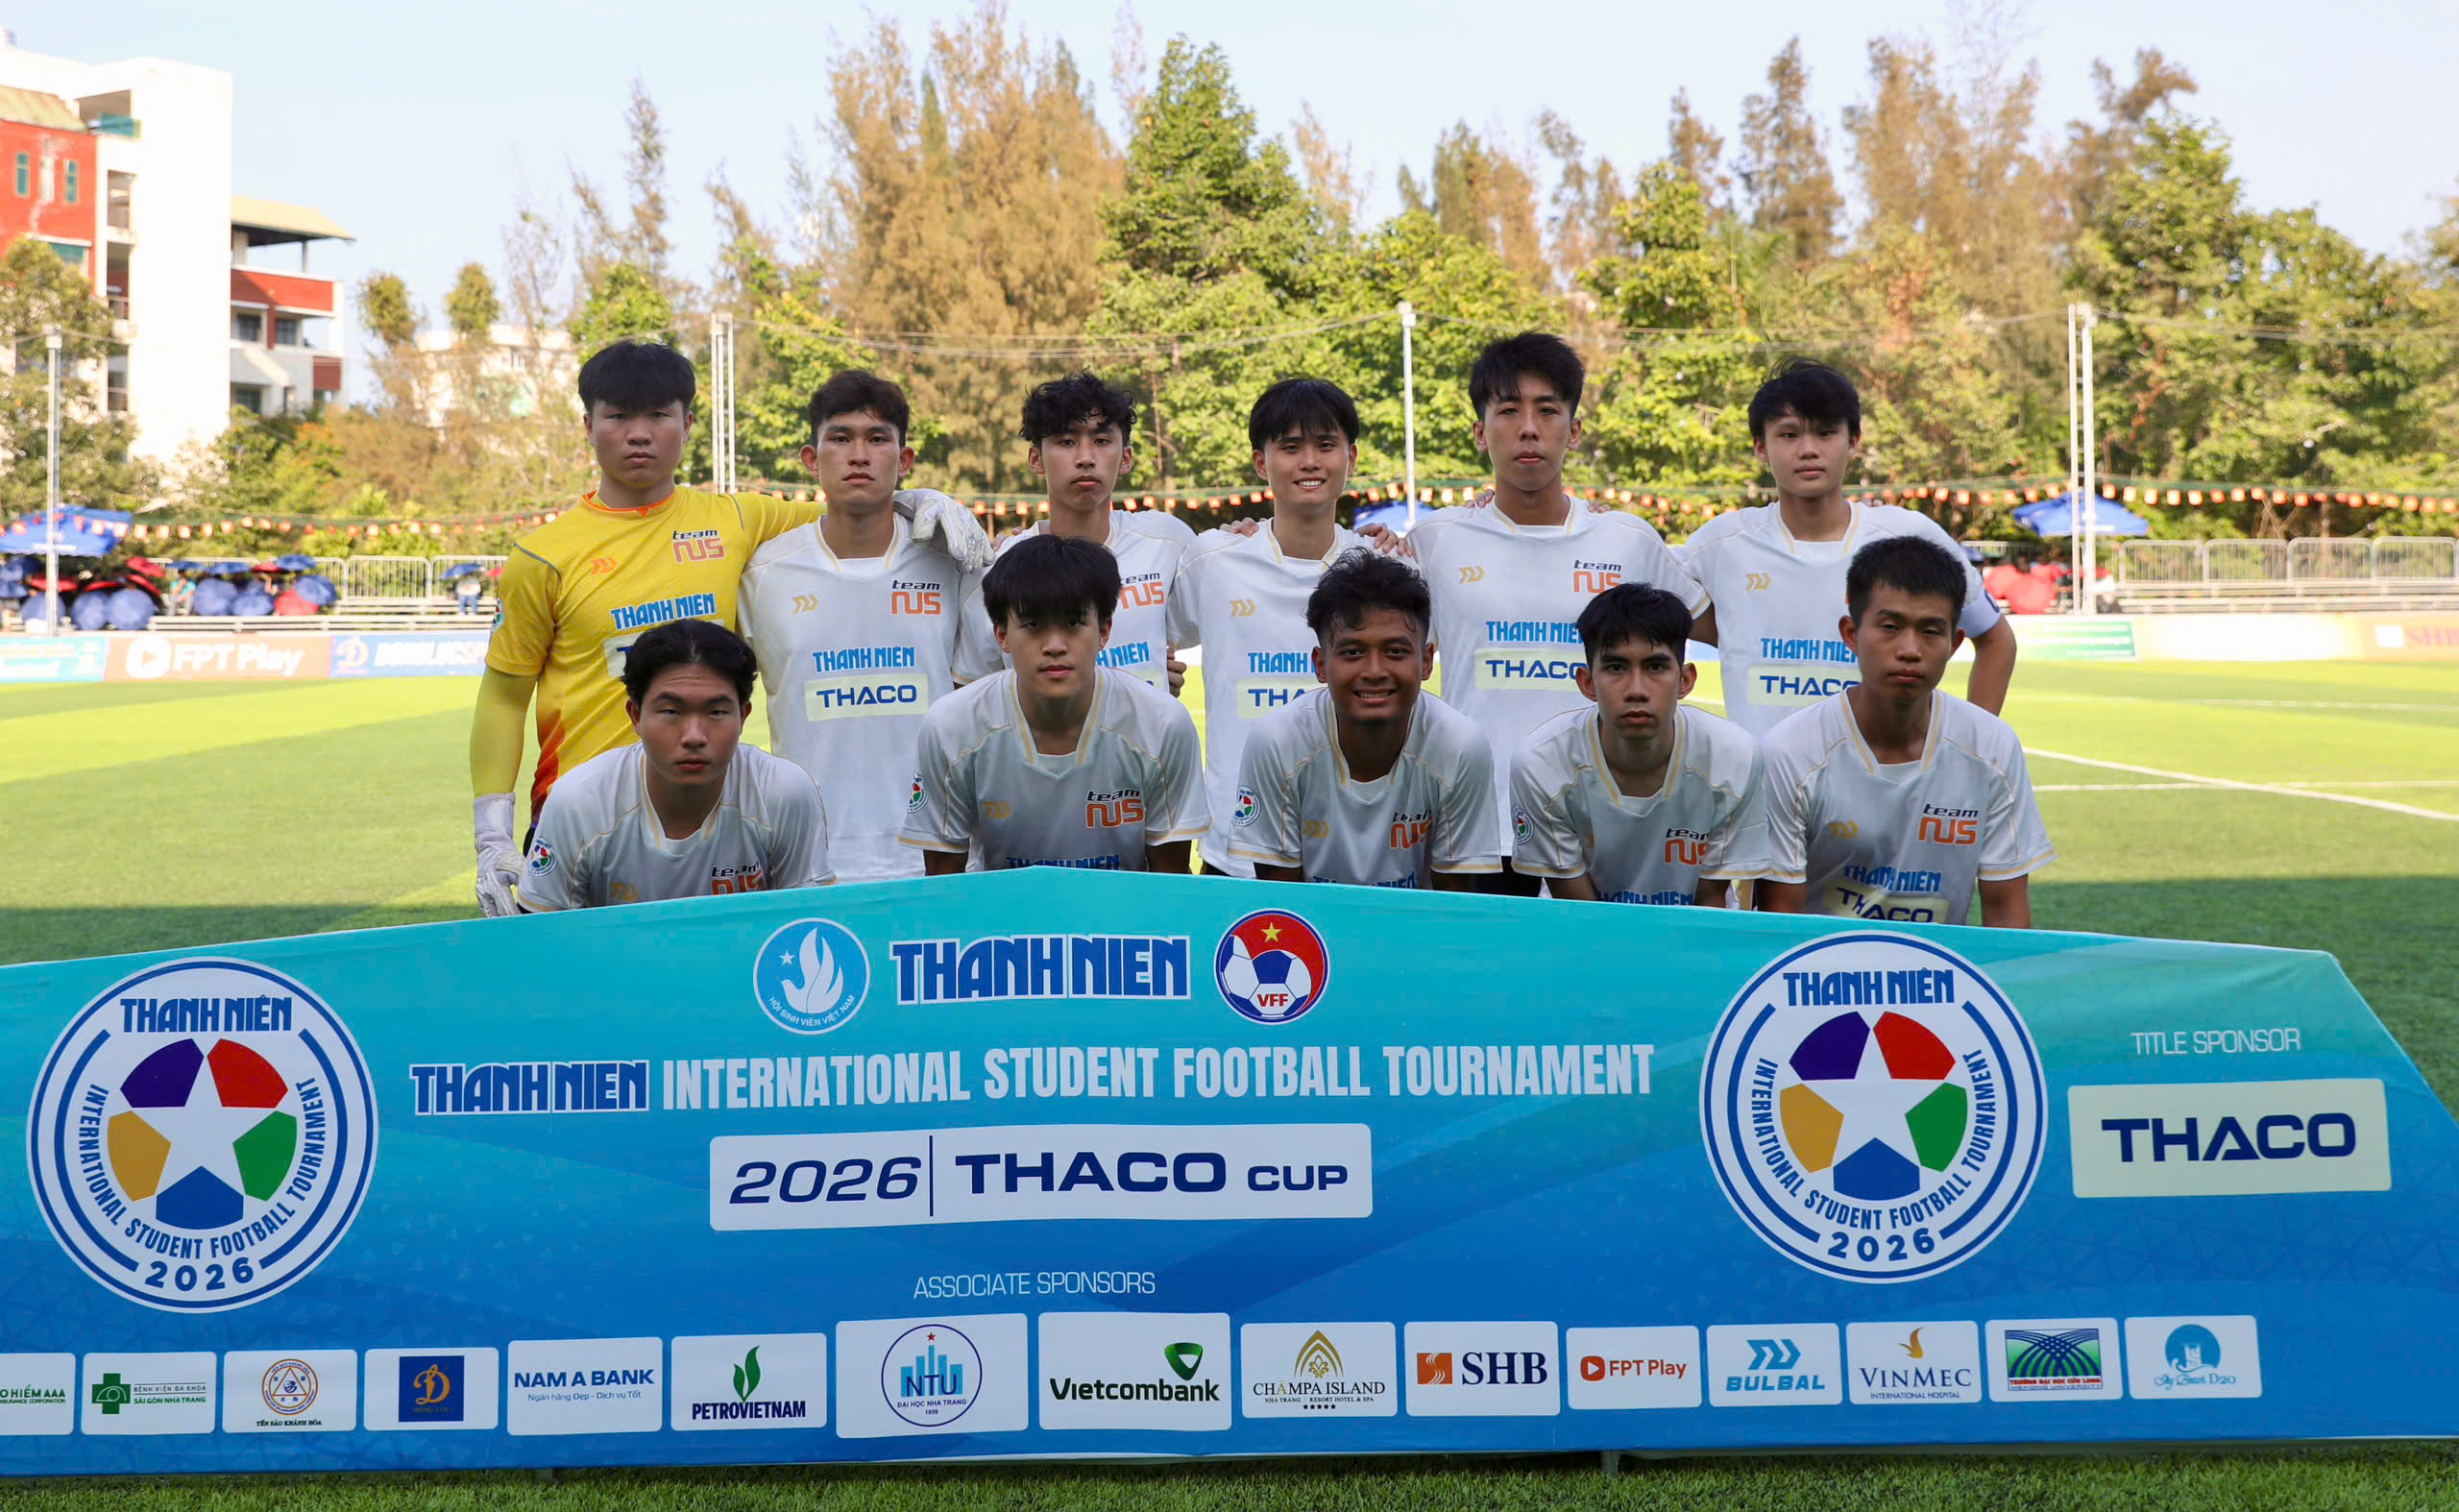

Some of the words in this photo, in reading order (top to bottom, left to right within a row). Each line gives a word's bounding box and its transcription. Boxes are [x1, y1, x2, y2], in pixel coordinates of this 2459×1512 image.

[672, 530, 718, 540] team
[1573, 560, 1621, 572] team
[891, 579, 940, 591] team
[1120, 573, 1160, 584] eam
[610, 598, 674, 630] THANH
[1485, 621, 1547, 642] THANH
[173, 645, 234, 671] FPT
[237, 644, 304, 677] Play
[812, 646, 873, 672] THANH
[1760, 638, 1821, 660] THANH
[1248, 652, 1308, 673] THANH
[816, 684, 917, 708] THACO
[1086, 789, 1141, 802] team
[1923, 803, 1979, 817] team
[889, 936, 1067, 1005] THANH
[1783, 971, 1884, 1006] THANH
[1887, 966, 1955, 1005] NIÊN
[780, 1010, 800, 1024] SINH
[800, 1017, 821, 1026] VIÊN
[840, 994, 856, 1012] NAM
[1256, 993, 1289, 1009] VFF
[120, 998, 220, 1033] THANH
[224, 994, 292, 1032] NIÊN
[2130, 1031, 2187, 1055] TITLE
[2193, 1028, 2302, 1054] SPONSOR
[410, 1061, 551, 1115] THANH
[663, 1051, 971, 1110] INTERNATIONAL
[983, 1046, 1158, 1100] STUDENT
[1173, 1046, 1371, 1099] FOOTBALL
[1383, 1044, 1655, 1096] TOURNAMENT
[1751, 1057, 1806, 1198] INTERNATIONAL
[1804, 1189, 1882, 1231] STUDENT
[1889, 1173, 1972, 1230] FOOTBALL
[1961, 1049, 1997, 1172] TOURNAMENT
[2101, 1111, 2356, 1162] THACO
[79, 1084, 127, 1226] INTERNATIONAL
[125, 1218, 203, 1259] STUDENT
[210, 1202, 295, 1258] FOOTBALL
[286, 1077, 326, 1202] TOURNAMENT
[729, 1156, 923, 1205] 2026
[955, 1151, 1228, 1194] THACO
[1247, 1164, 1349, 1192] CUP
[1827, 1228, 1936, 1262] 2026
[144, 1256, 254, 1292] 2026
[913, 1273, 1031, 1300] ASSOCIATE
[1037, 1270, 1156, 1296] SPONSORS
[514, 1372, 568, 1388] NAM
[571, 1371, 587, 1387] A
[592, 1368, 654, 1386] BANK
[1461, 1352, 1547, 1384] SHB
[1609, 1360, 1644, 1377] FPT
[1648, 1359, 1688, 1379] Play
[43, 1388, 66, 1398] AAA
[906, 1374, 958, 1397] NTU
[1049, 1378, 1221, 1402] Vietcombank
[1326, 1381, 1386, 1395] ISLAND
[1725, 1375, 1825, 1391] BULBAL
[550, 1392, 572, 1402] hàng
[692, 1401, 807, 1421] PETROVIETNAM
